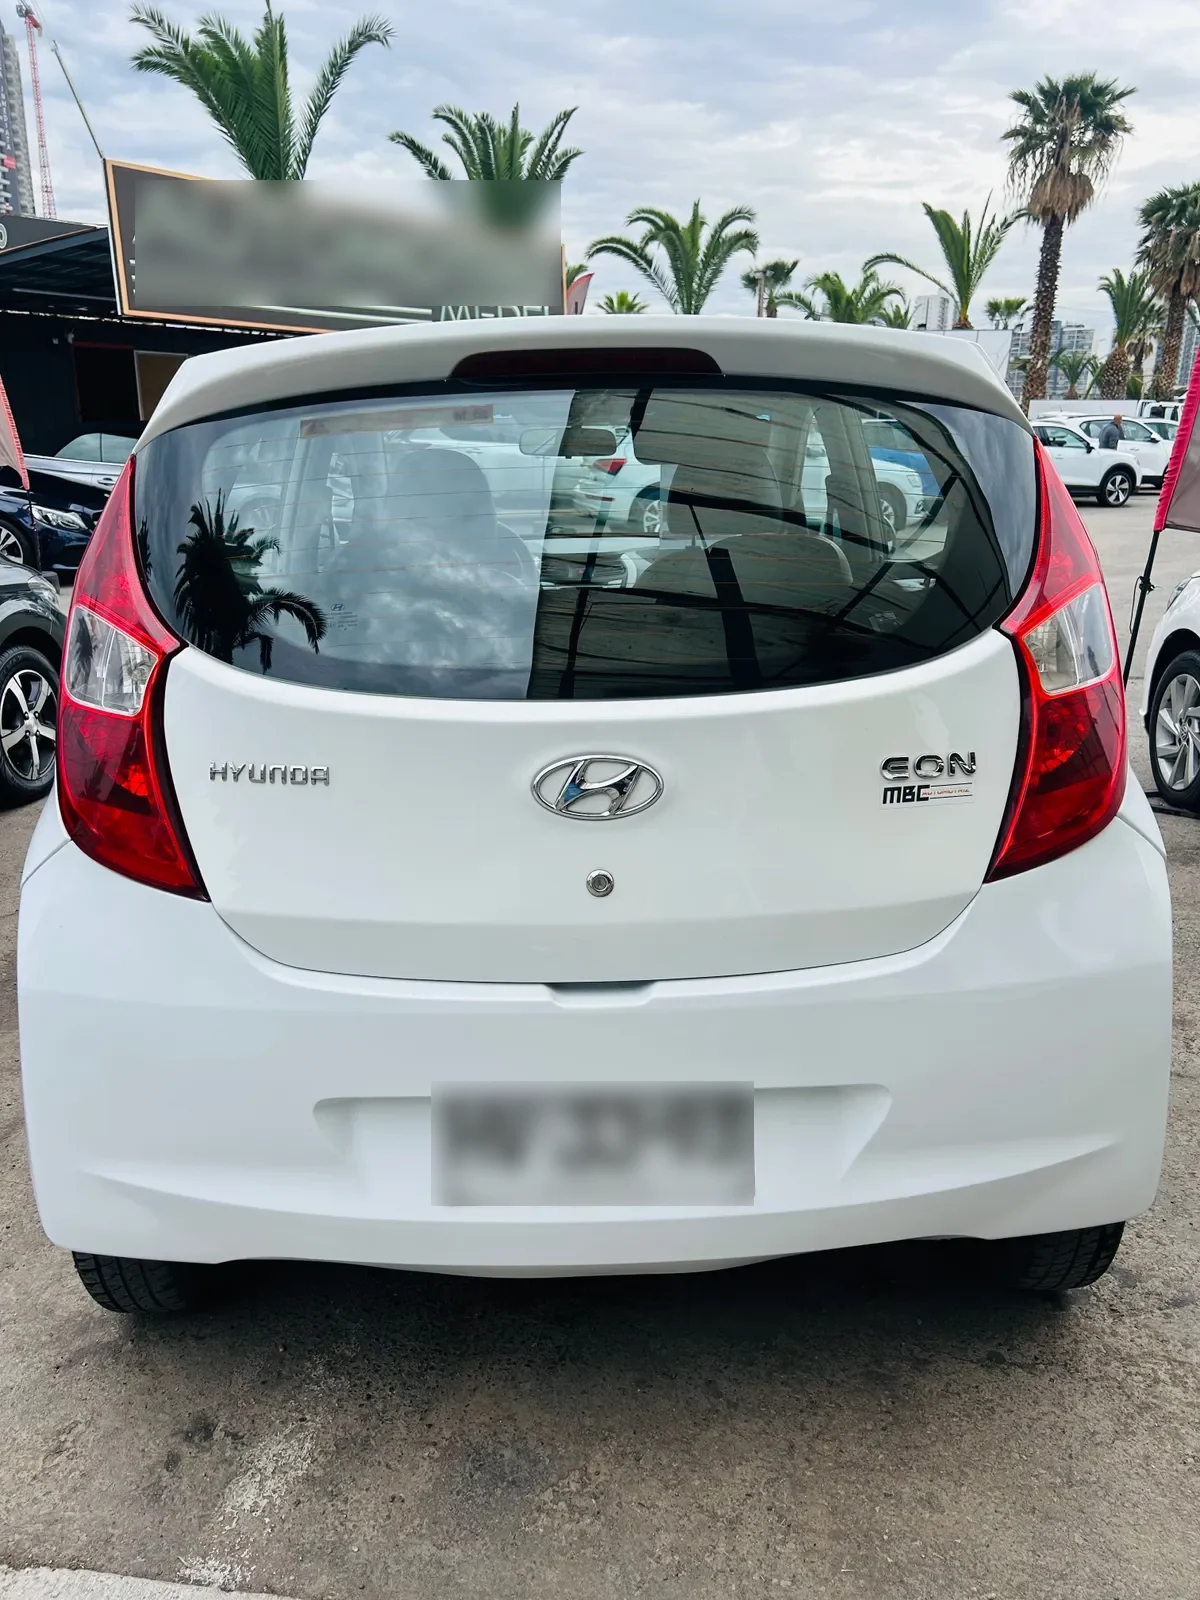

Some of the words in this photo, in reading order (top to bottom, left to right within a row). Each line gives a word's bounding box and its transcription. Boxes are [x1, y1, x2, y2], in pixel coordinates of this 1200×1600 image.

[209, 760, 330, 786] HYUNDA
[880, 751, 977, 781] EON
[882, 784, 931, 805] MBC
